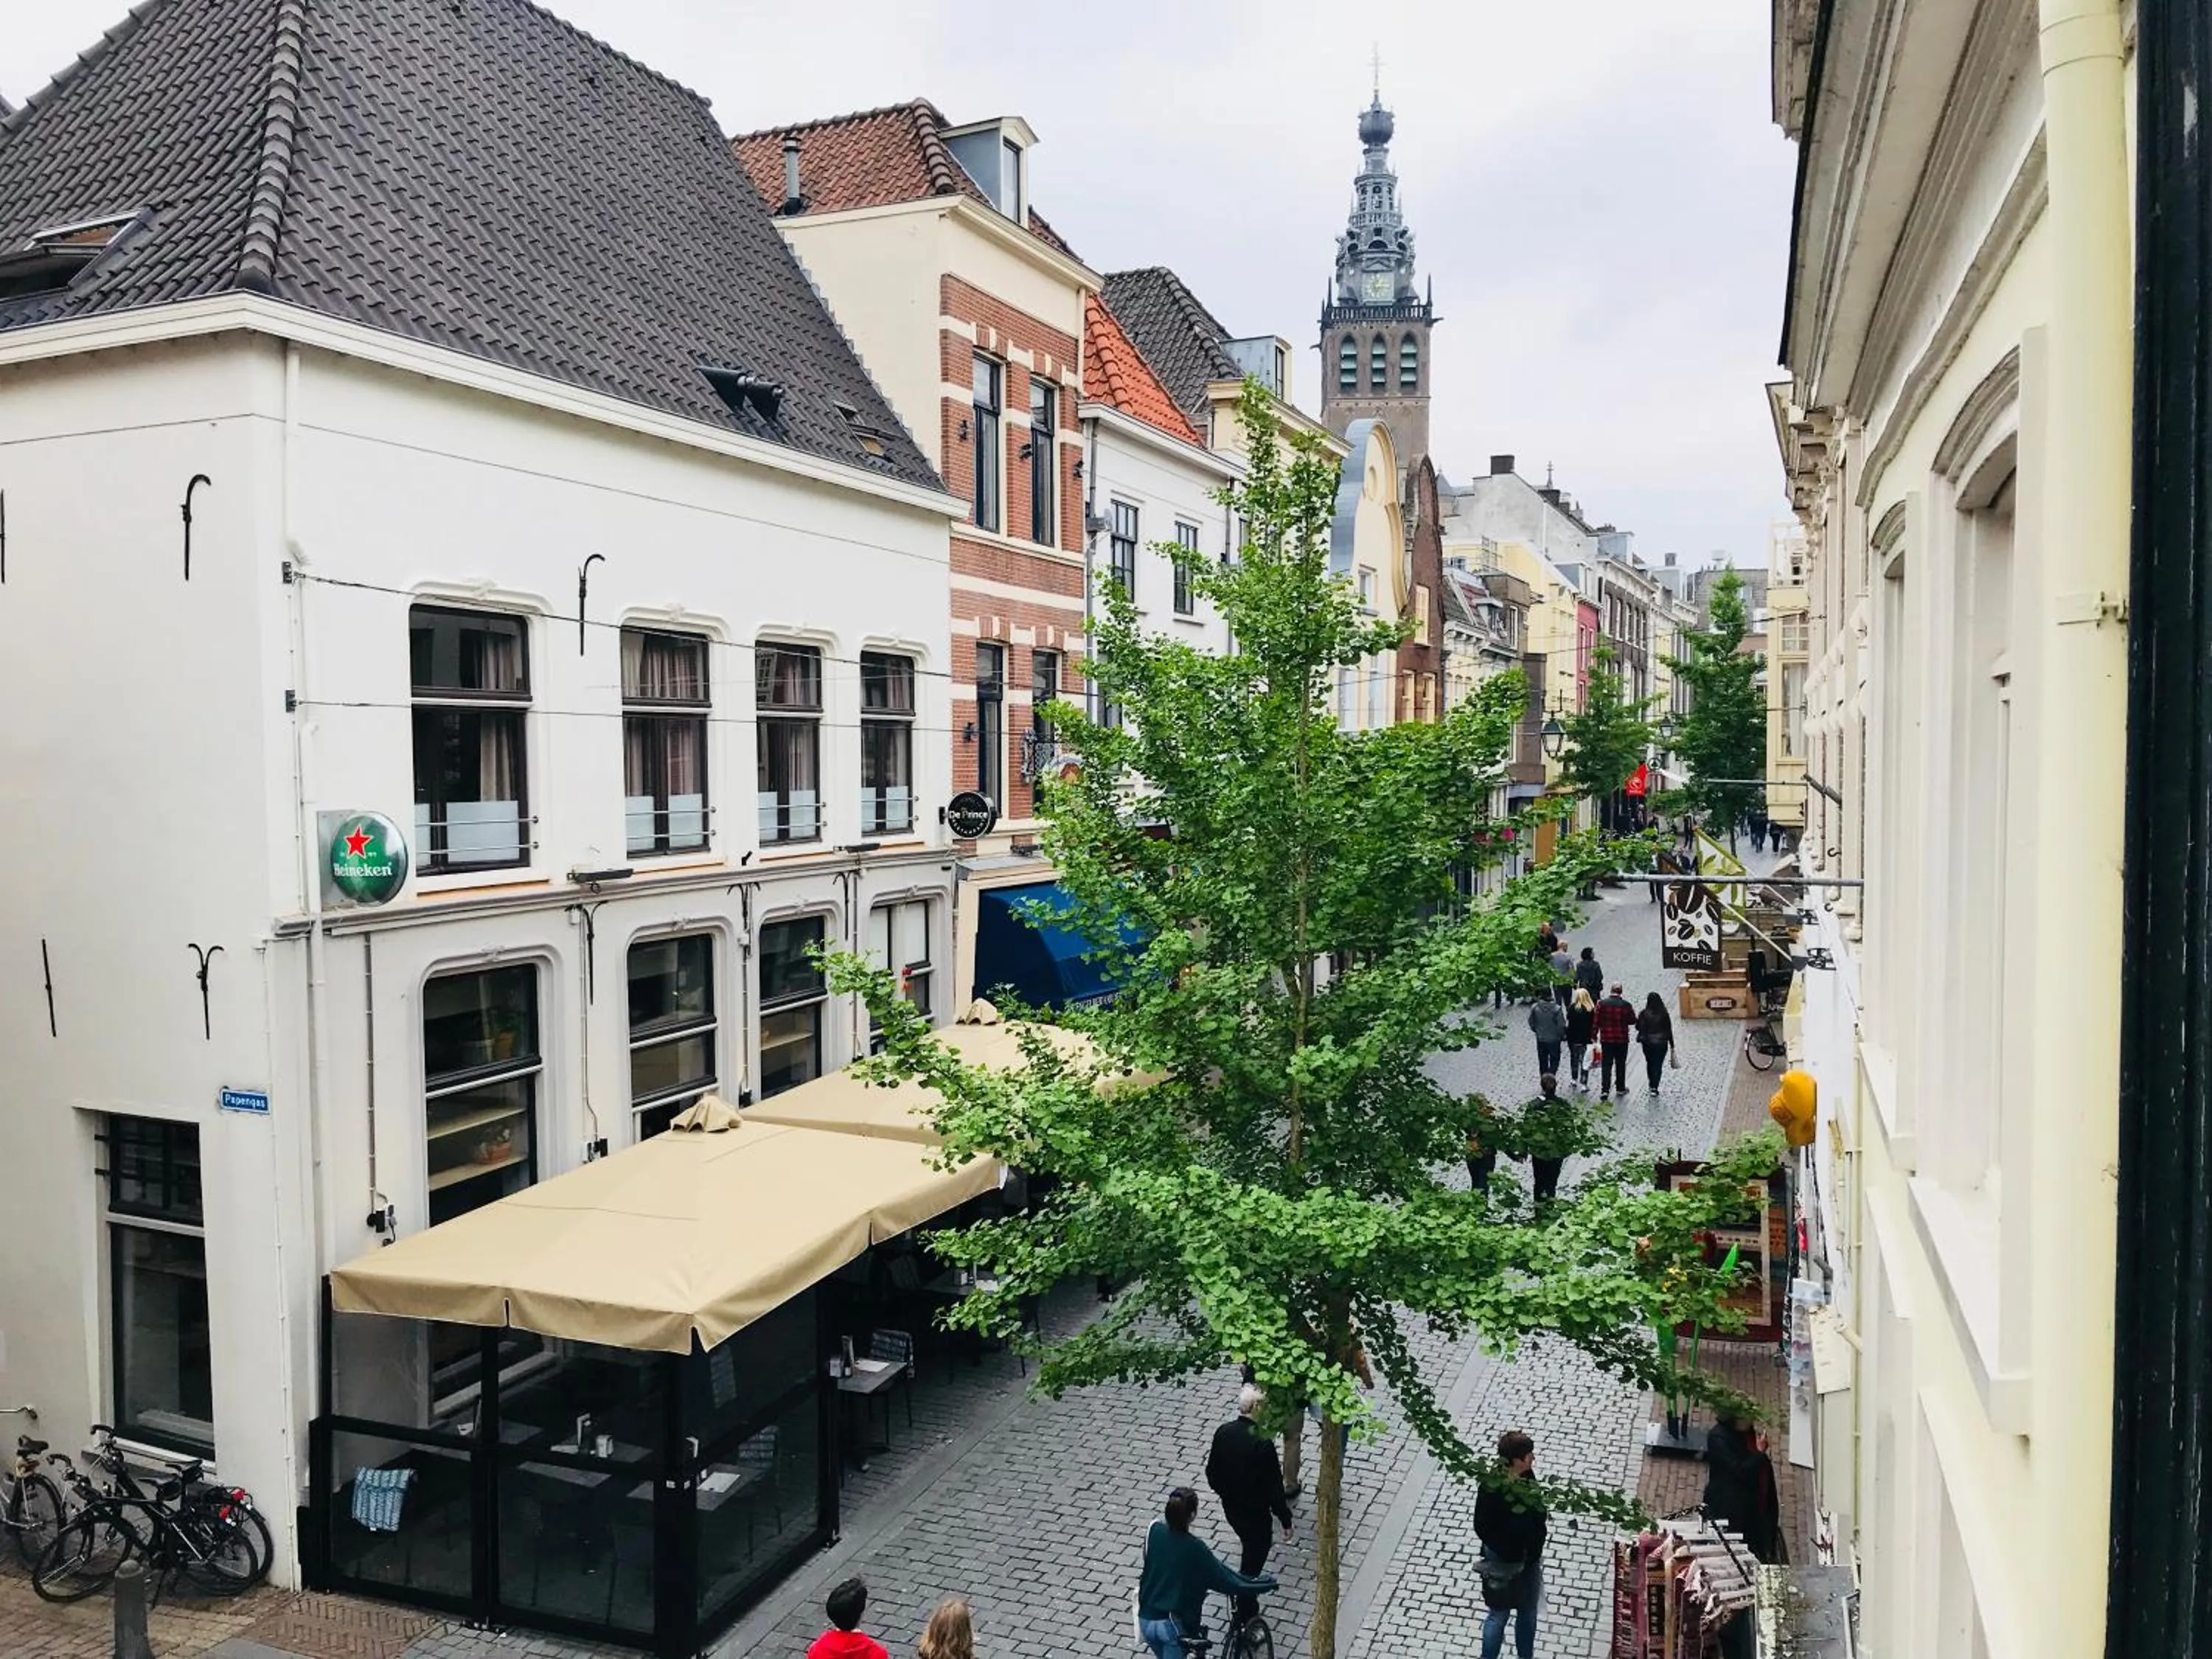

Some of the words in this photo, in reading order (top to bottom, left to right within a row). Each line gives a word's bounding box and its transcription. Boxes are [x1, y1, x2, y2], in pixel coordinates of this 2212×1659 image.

[949, 810, 961, 819] De
[333, 862, 393, 877] Heineken
[1673, 952, 1712, 965] KOFFIE
